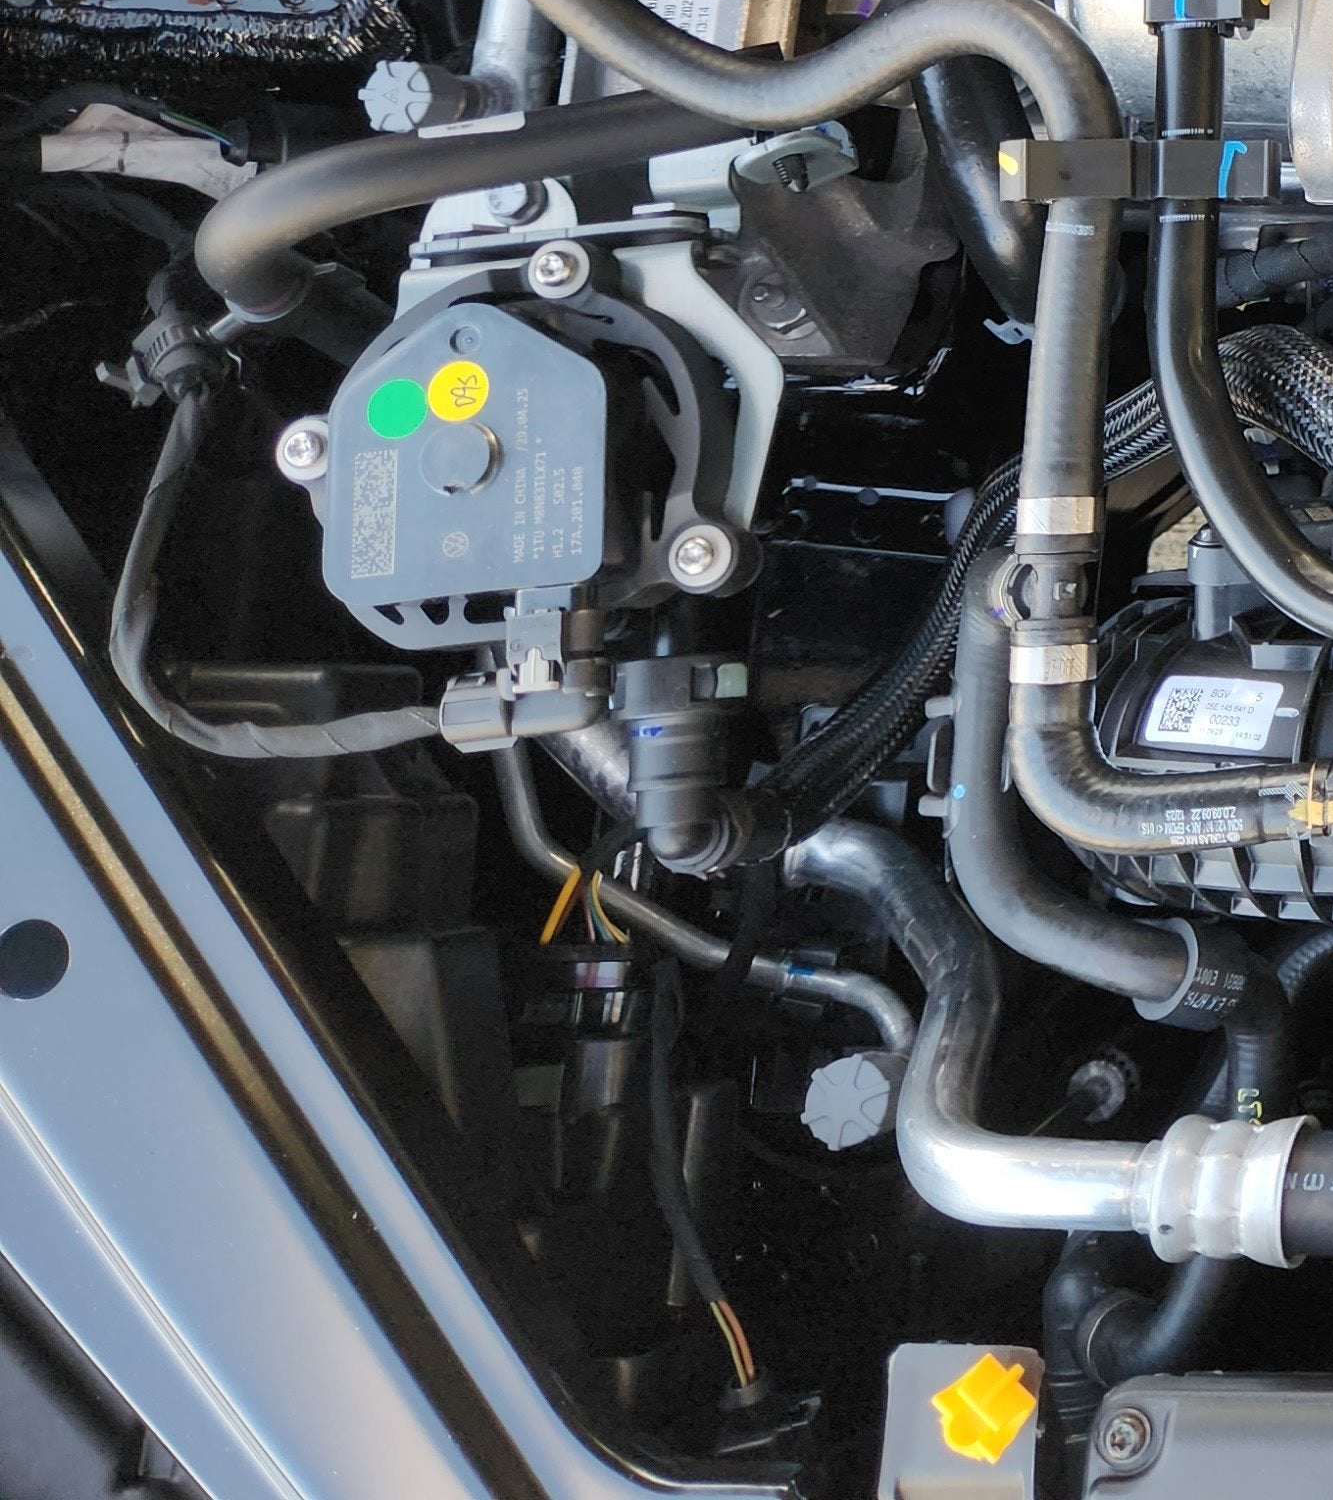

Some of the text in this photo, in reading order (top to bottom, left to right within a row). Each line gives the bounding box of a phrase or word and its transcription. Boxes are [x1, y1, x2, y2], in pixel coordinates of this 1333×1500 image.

[514, 467, 527, 504] CHINA
[514, 510, 526, 526] IN
[513, 532, 526, 564] MADE
[1210, 688, 1265, 702] BGV 5
[1247, 706, 1255, 714] D
[1209, 713, 1241, 727] 00233
[1301, 1171, 1327, 1194] (T)
